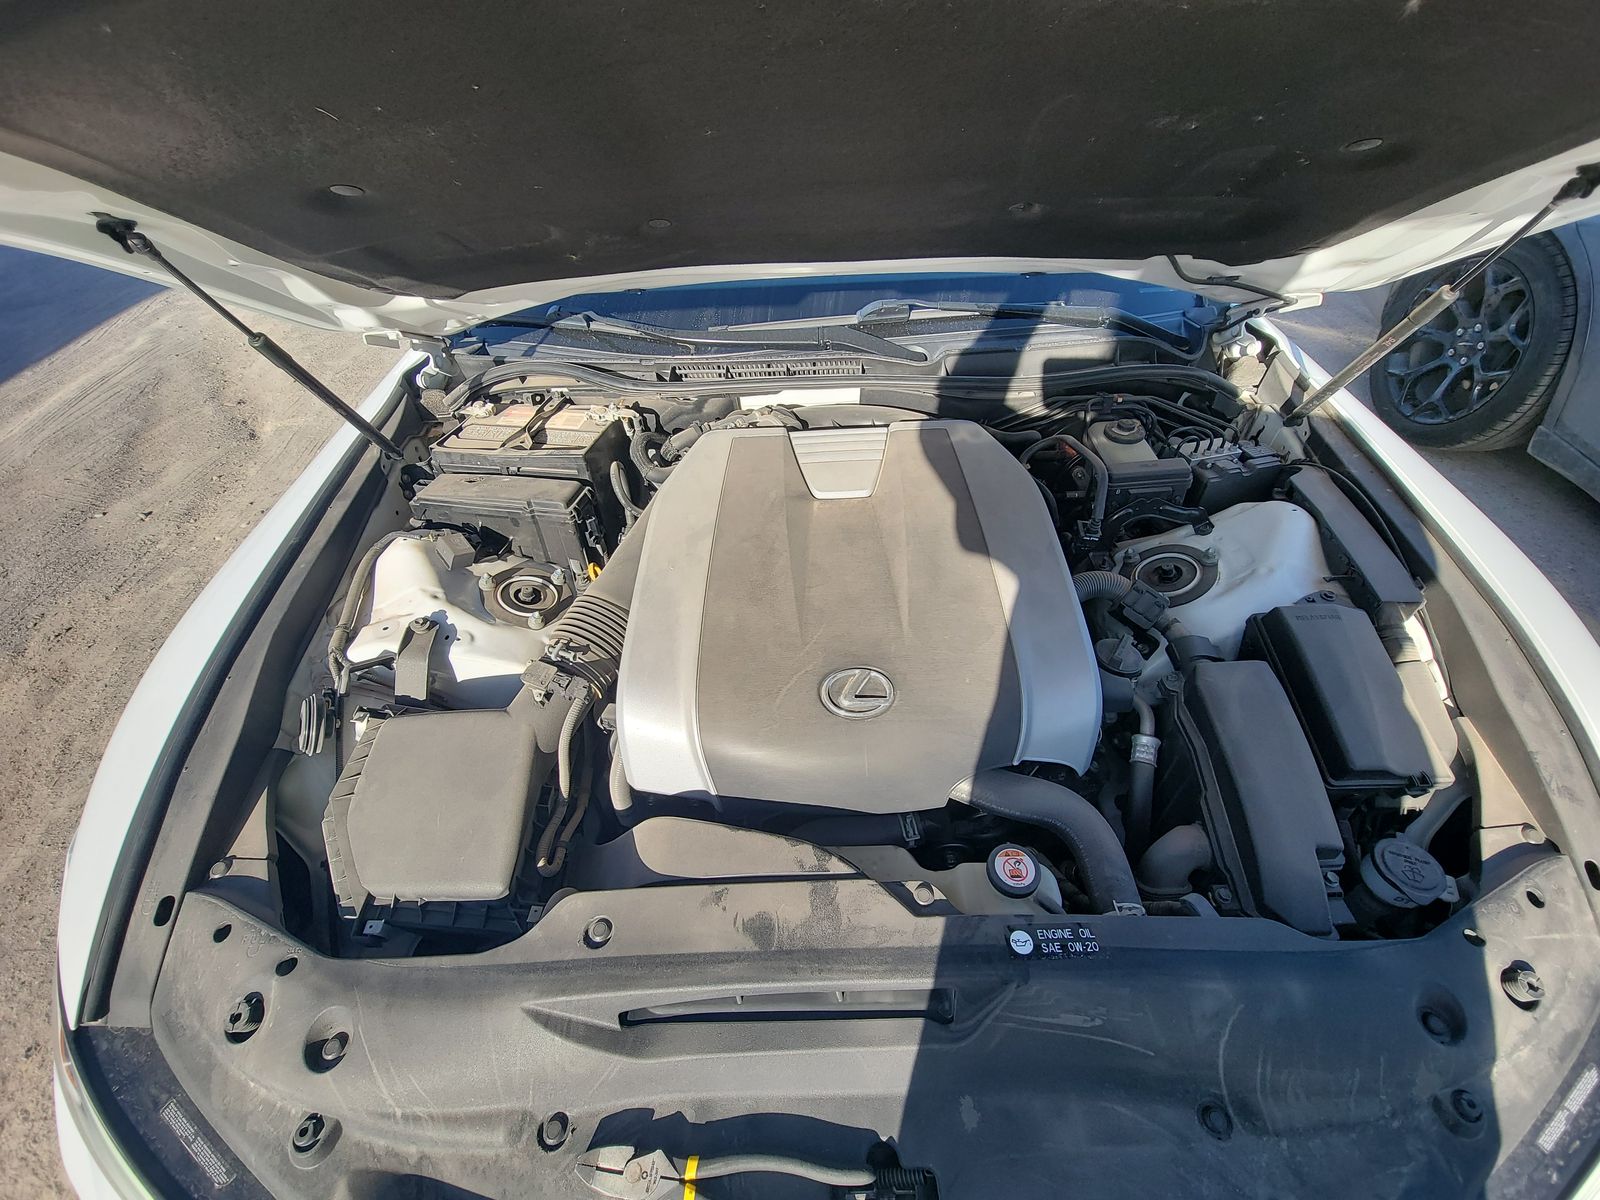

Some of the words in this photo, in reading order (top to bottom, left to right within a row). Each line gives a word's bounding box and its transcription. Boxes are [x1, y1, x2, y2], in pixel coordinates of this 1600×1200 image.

[1036, 928, 1074, 940] ENGINE
[1078, 928, 1096, 939] OIL
[1041, 942, 1063, 953] SAE
[1067, 941, 1100, 952] 0W-20
